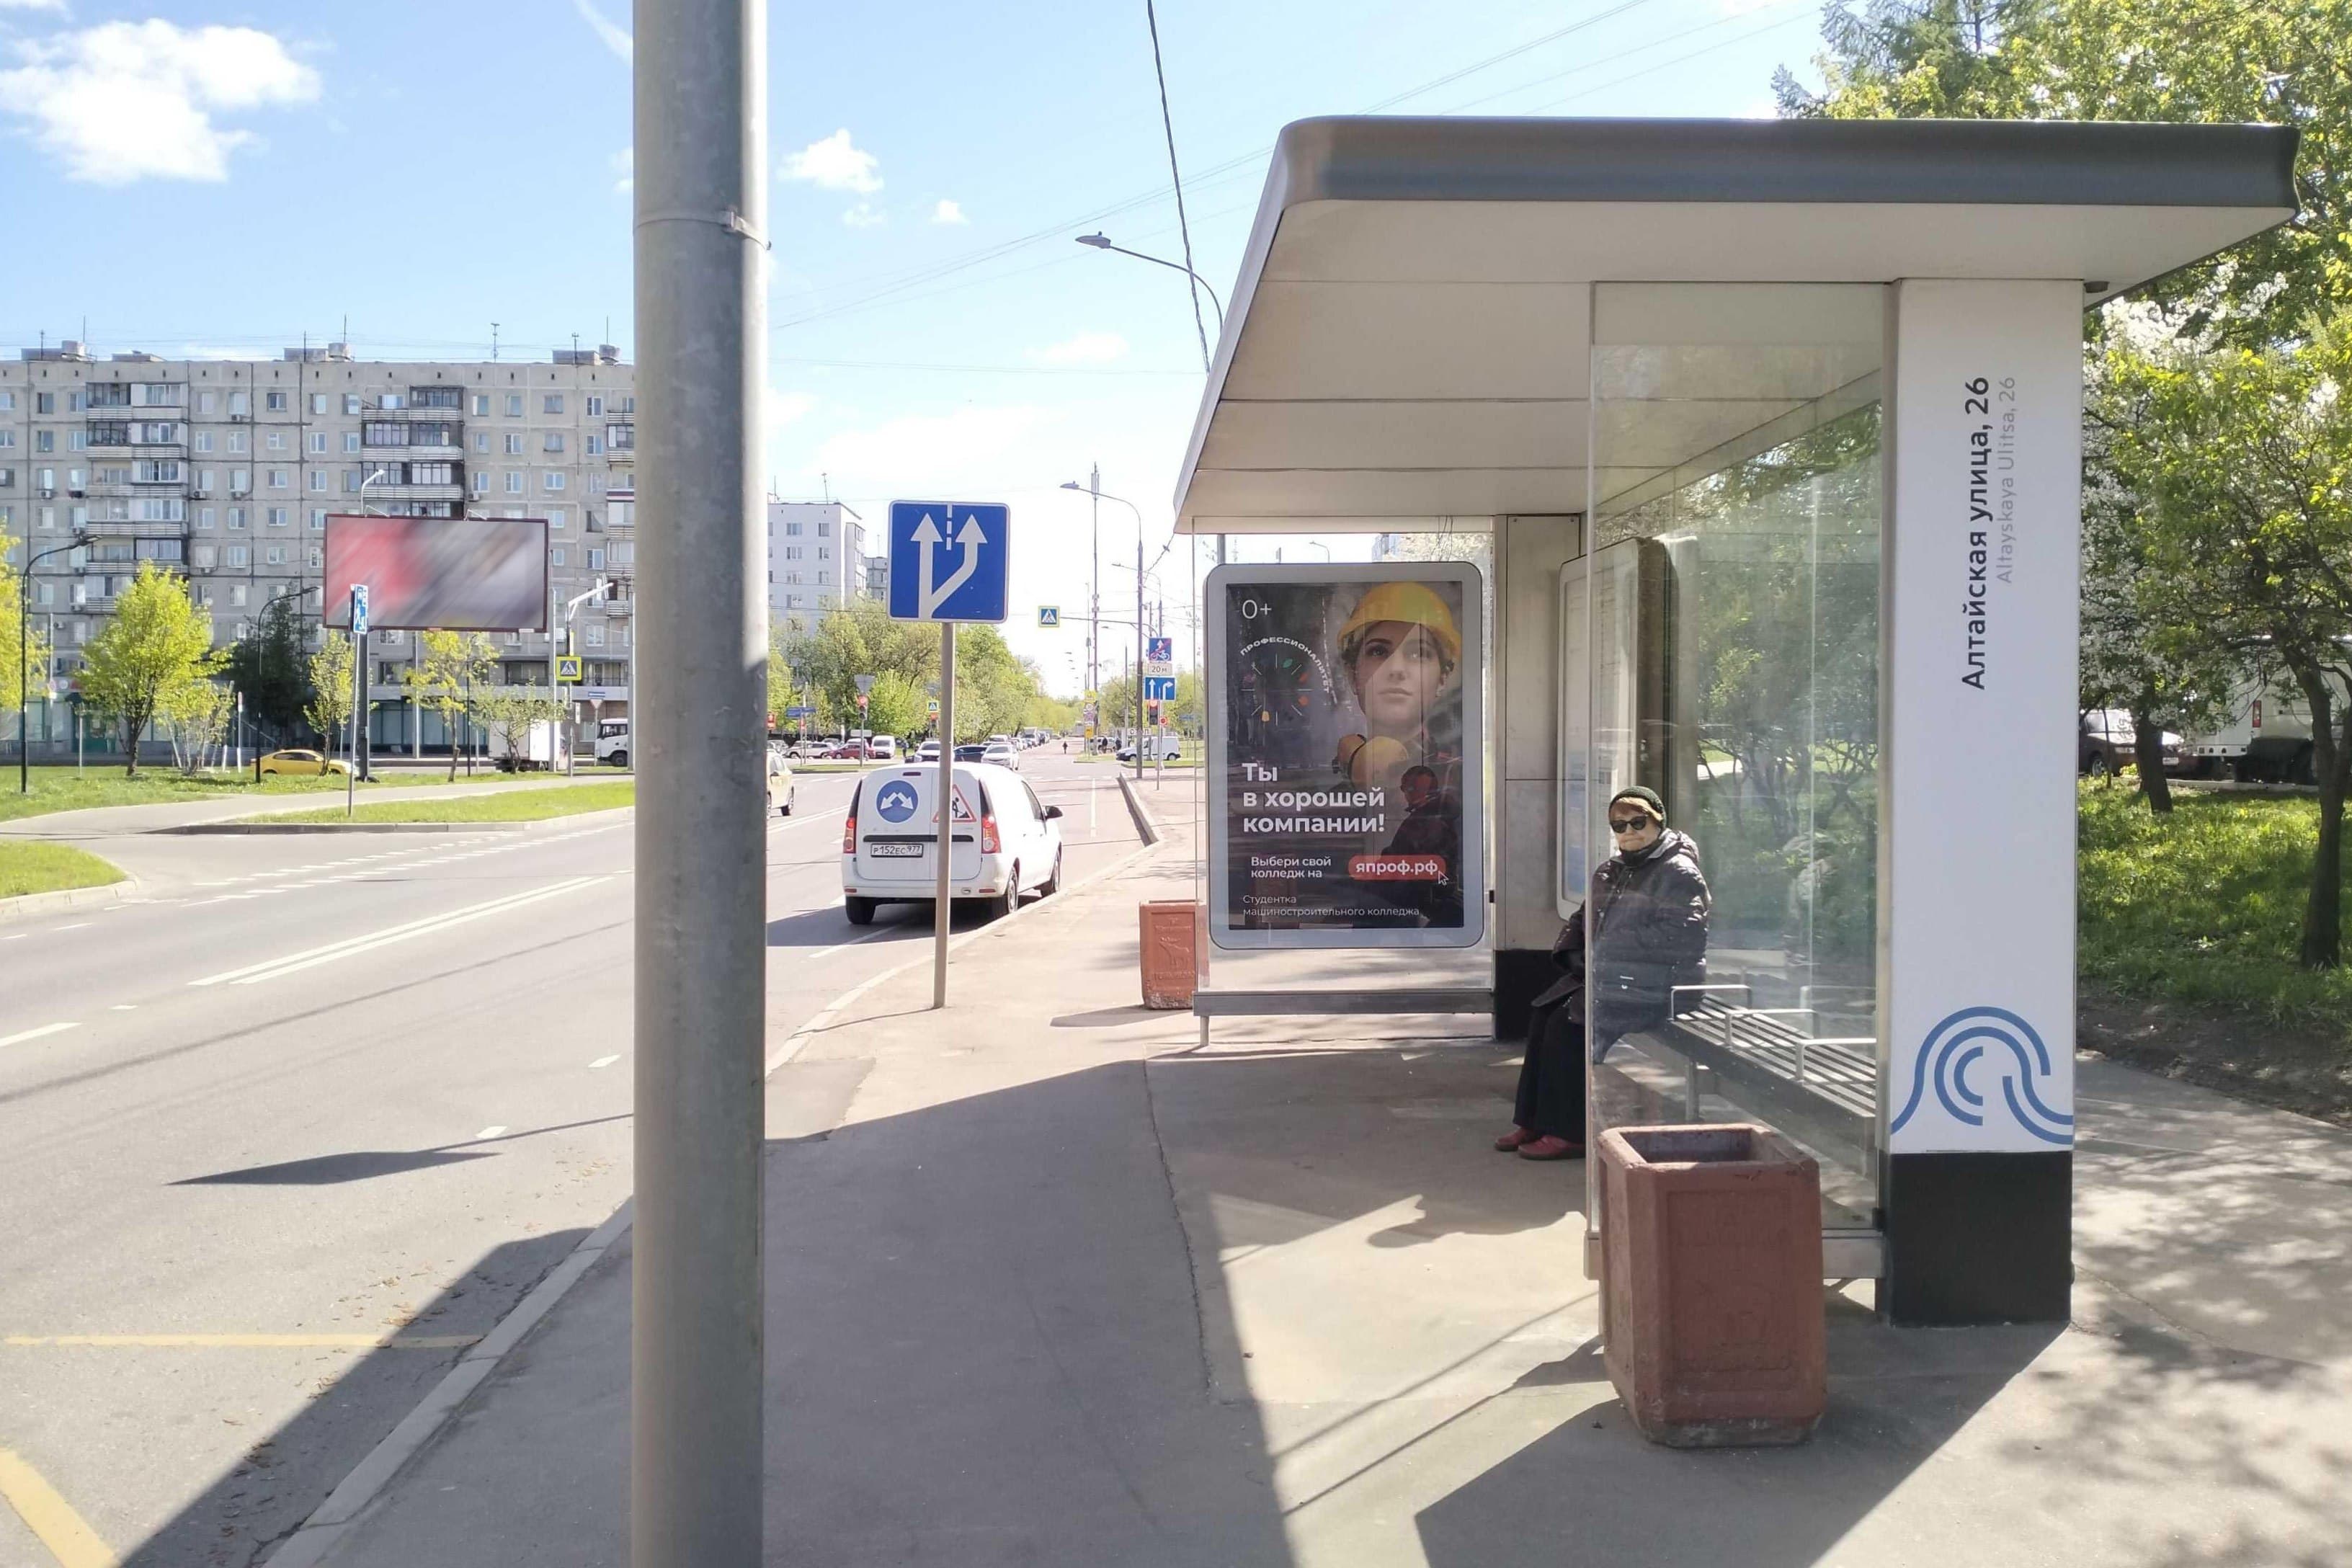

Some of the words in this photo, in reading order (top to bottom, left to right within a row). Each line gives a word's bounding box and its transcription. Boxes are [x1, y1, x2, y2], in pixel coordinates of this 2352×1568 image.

[1964, 377, 1989, 414] 26
[1999, 377, 2015, 401] 26
[1997, 408, 2017, 470] Ulitsa,
[1970, 424, 1993, 522] улица,
[1996, 477, 2016, 584] Altayskaya
[1242, 599, 1273, 620] 0+
[1961, 532, 1987, 690] Алтайская
[1239, 636, 1330, 694] ПРОФЕССИОНАЛИТЕТ
[1242, 762, 1278, 782] Ты
[1243, 792, 1257, 807] в
[1265, 787, 1384, 811] хорошей
[1243, 814, 1384, 832] компании!
[1251, 856, 1300, 868] Выбери
[1302, 856, 1332, 866] свой
[1355, 860, 1439, 876] япроф.рф
[1251, 869, 1306, 879] колледж
[1242, 894, 1298, 906] Студентка
[1243, 907, 1366, 917] машиностроительного
[1367, 907, 1420, 917] колледжа
